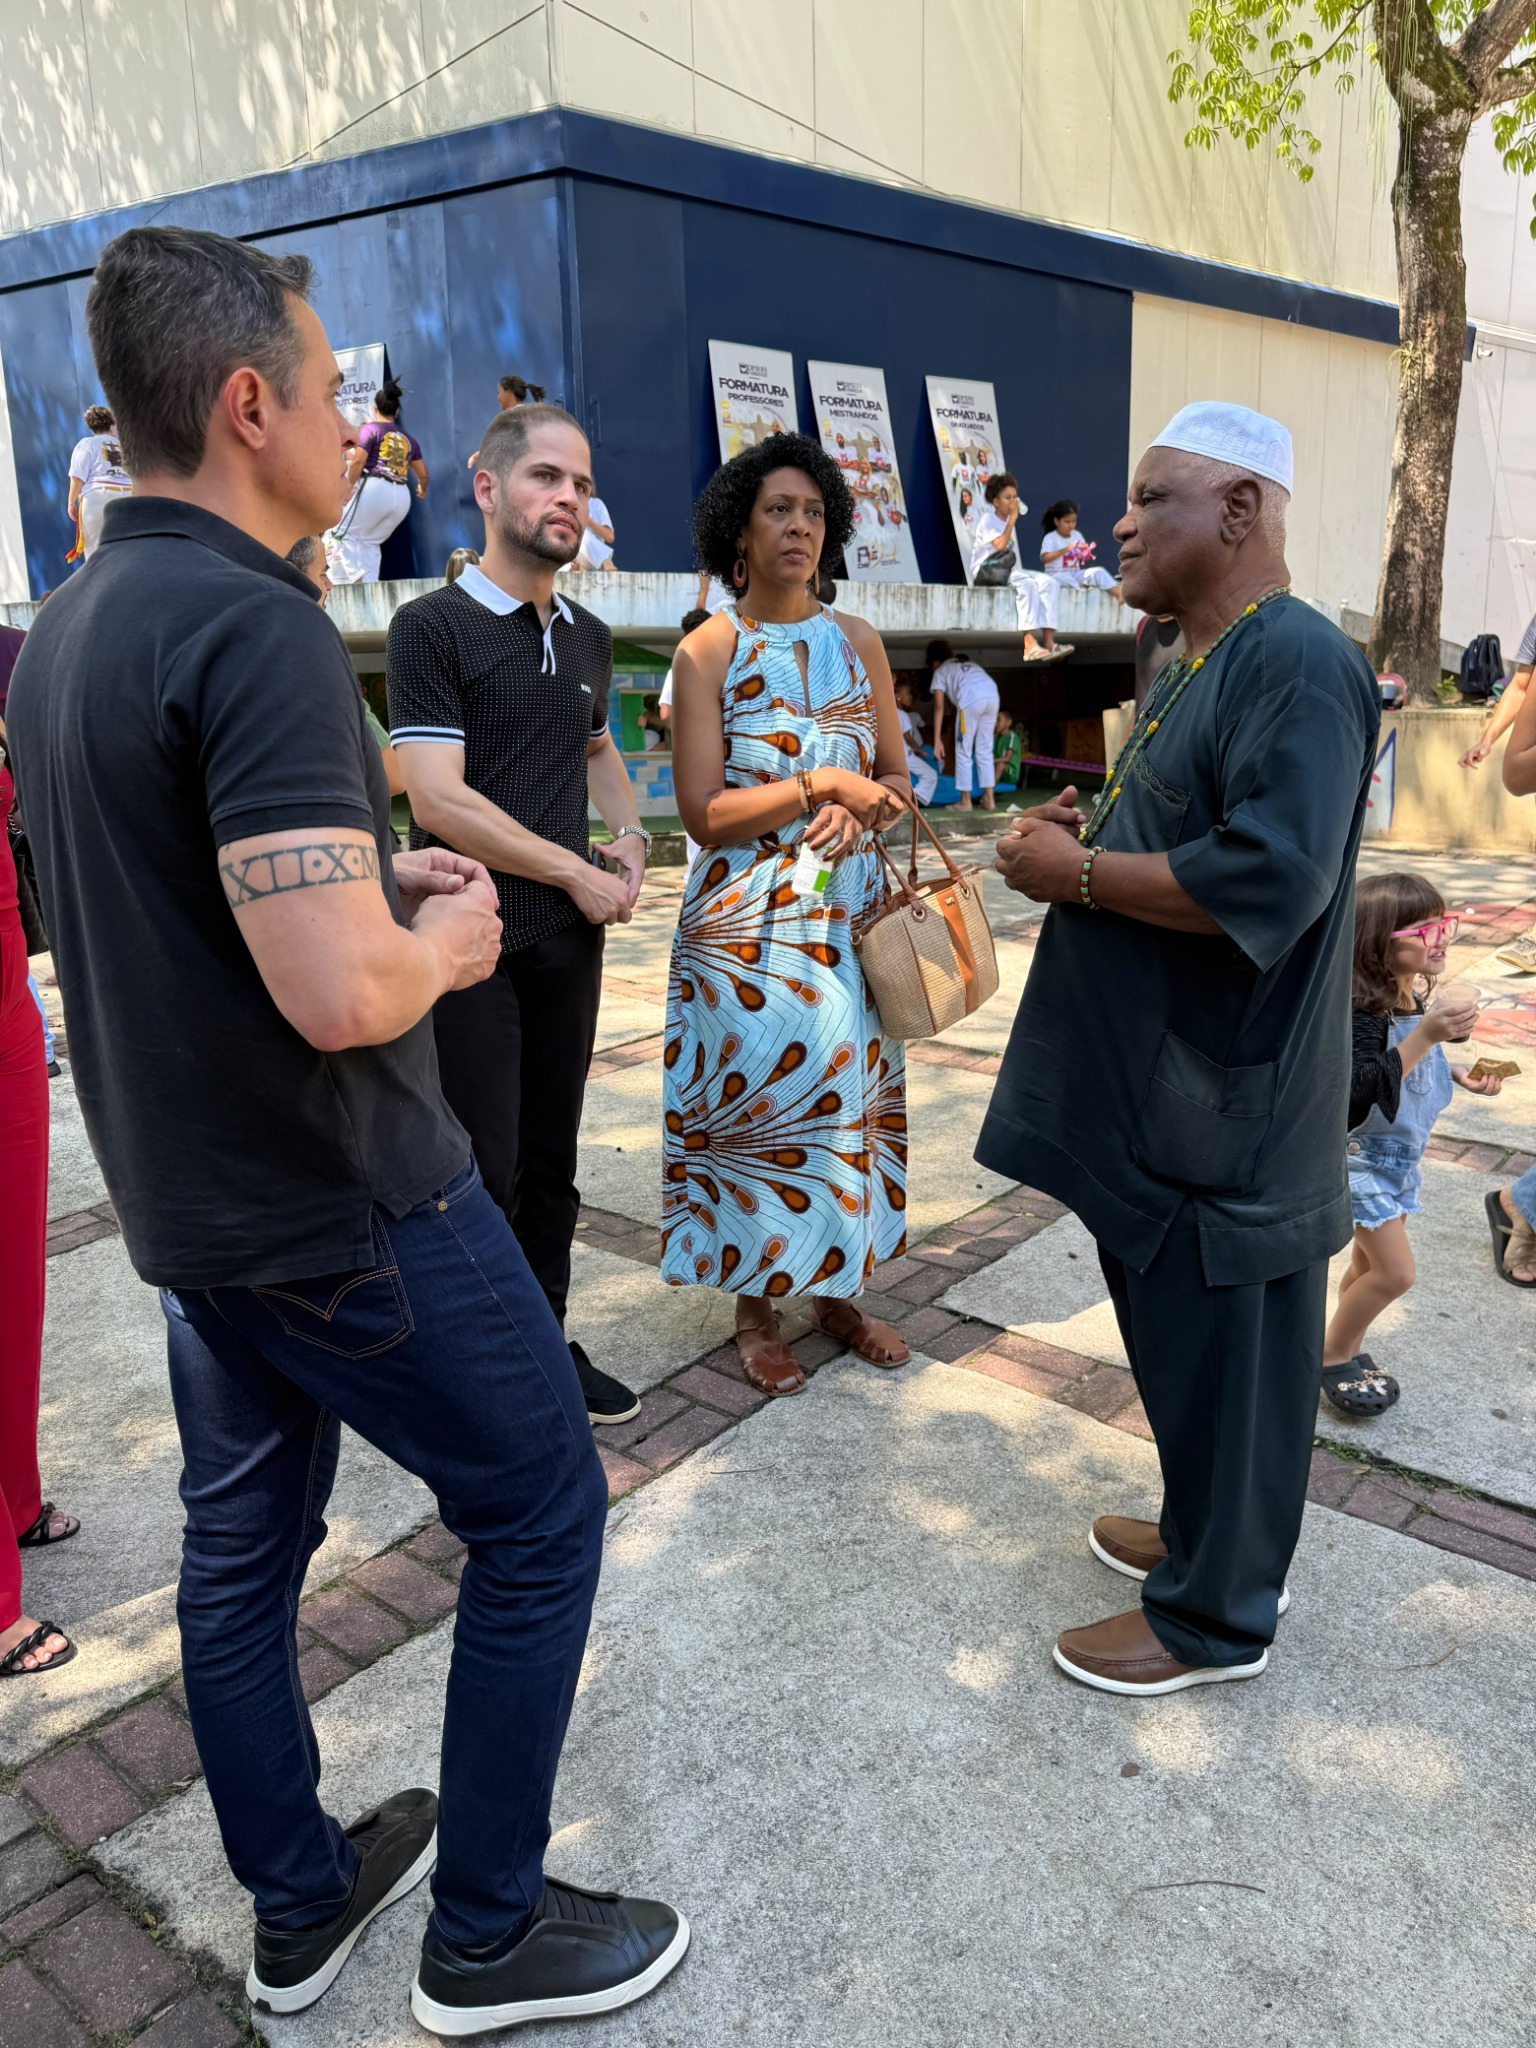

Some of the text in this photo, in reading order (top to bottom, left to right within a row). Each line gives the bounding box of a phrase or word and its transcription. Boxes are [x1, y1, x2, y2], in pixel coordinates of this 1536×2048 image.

[719, 377, 789, 398] FORMATURA
[728, 393, 784, 407] PROFESSORES
[819, 395, 883, 412] FORMATURA
[830, 409, 879, 421] MESTRANDOS
[936, 408, 993, 423] FORMATURA
[950, 421, 985, 431] GRADUADOS
